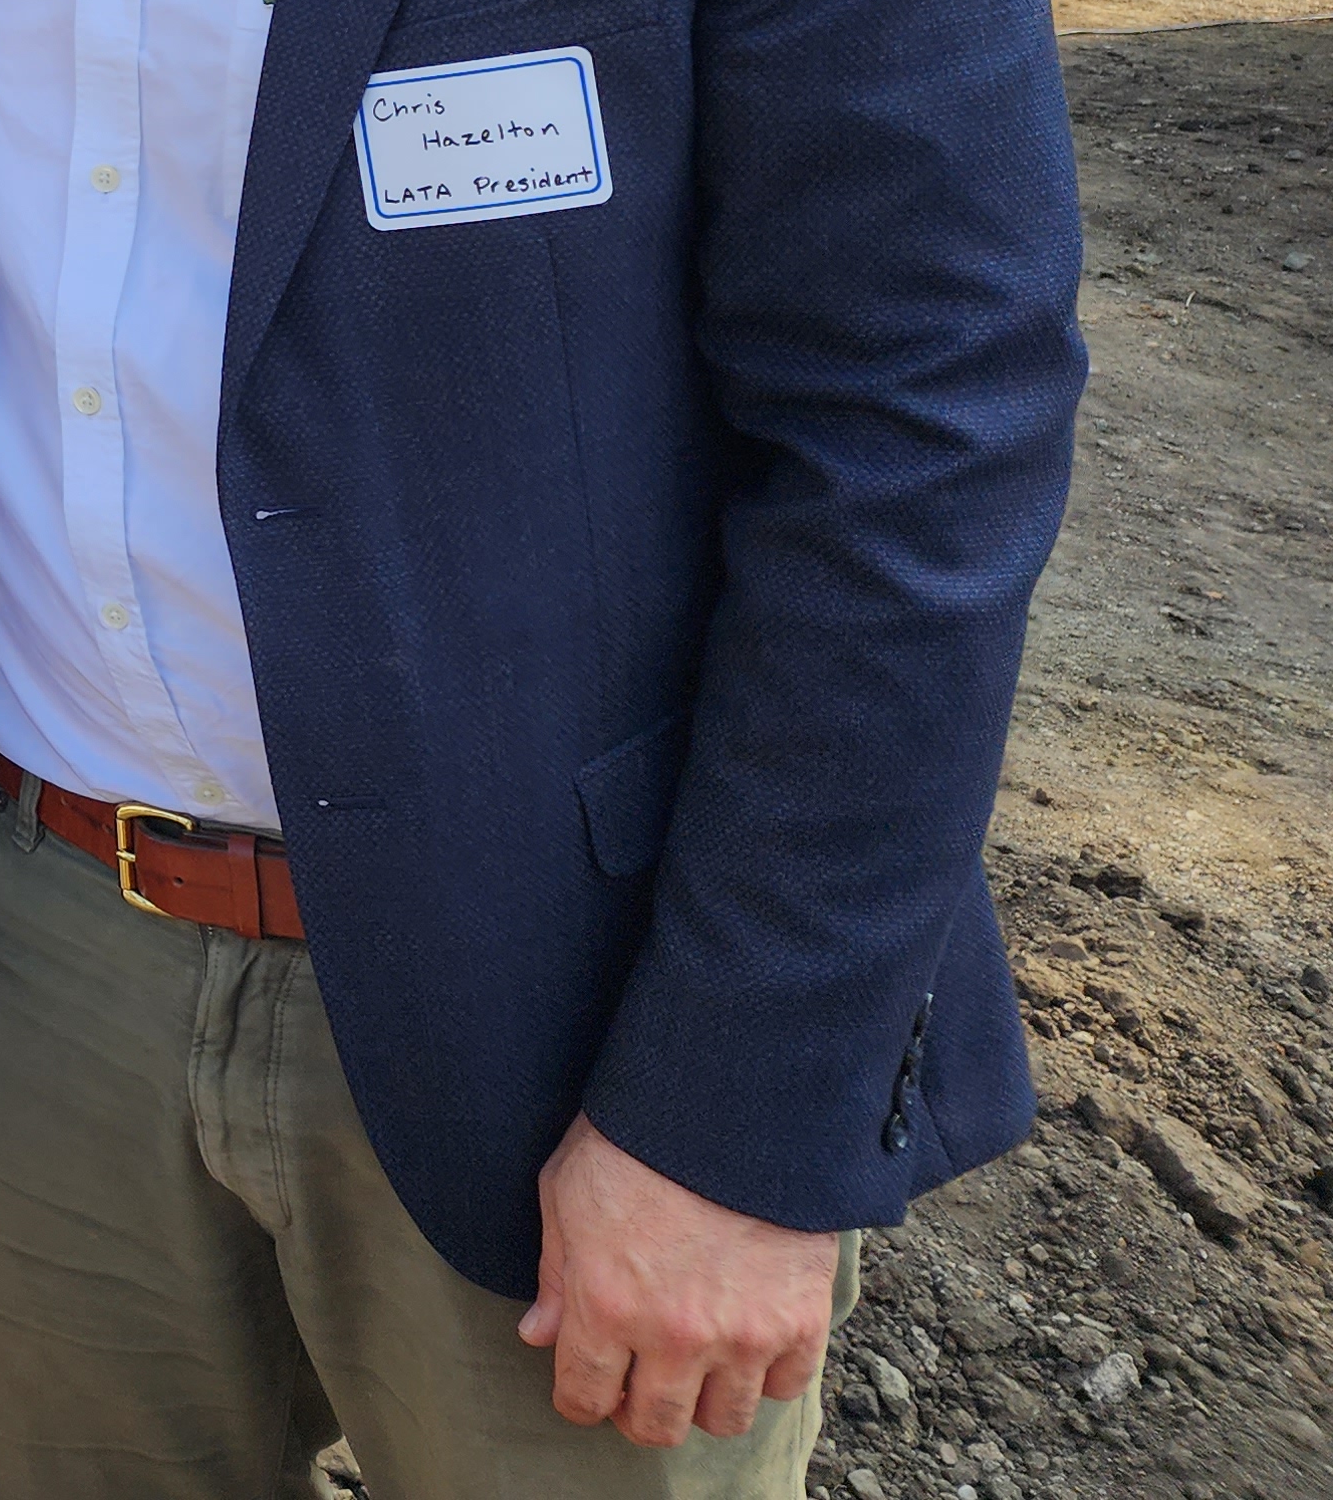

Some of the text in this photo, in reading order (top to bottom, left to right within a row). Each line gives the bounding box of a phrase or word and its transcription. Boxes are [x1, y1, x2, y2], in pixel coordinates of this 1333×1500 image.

[373, 93, 446, 122] Chris
[422, 120, 560, 150] Hazelton
[384, 166, 593, 205] LATA President
